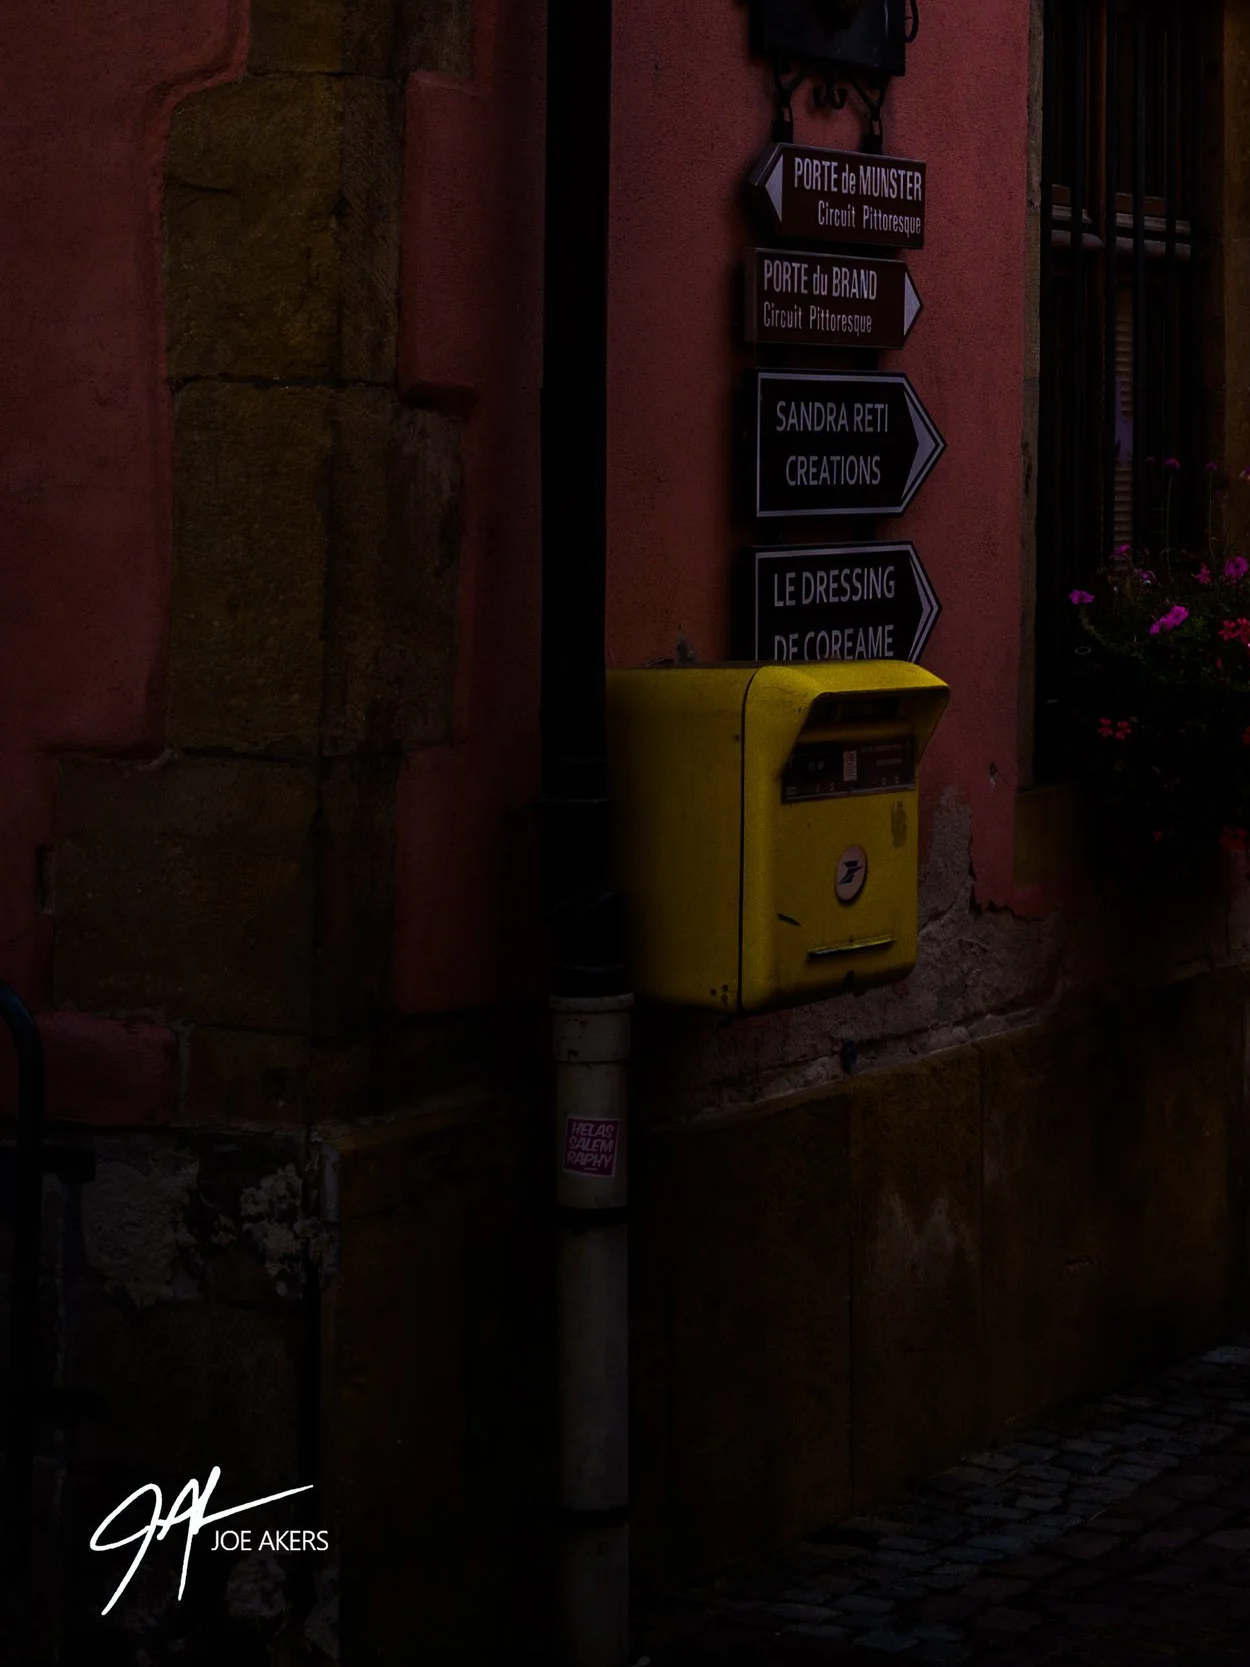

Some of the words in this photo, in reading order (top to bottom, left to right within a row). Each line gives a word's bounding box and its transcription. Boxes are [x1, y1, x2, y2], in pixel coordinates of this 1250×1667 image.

[794, 157, 838, 193] PORTE
[841, 164, 856, 195] de
[859, 165, 922, 202] MUNSTER
[817, 199, 856, 229] Circuit
[862, 204, 921, 238] Pittoresque
[763, 259, 808, 294] PORTE
[812, 265, 828, 296] du
[832, 266, 878, 301] BRAND
[763, 301, 802, 330] Circuit
[809, 304, 872, 337] Pittoresque
[775, 400, 849, 433] SANDRA
[853, 402, 889, 434] RETI
[785, 455, 881, 486] CREATIONS
[773, 571, 797, 607] LE
[801, 566, 896, 606] DRESSING
[568, 1135, 615, 1154] SALEM
[571, 1121, 614, 1138] HELAS
[566, 1150, 614, 1169] RAPHY
